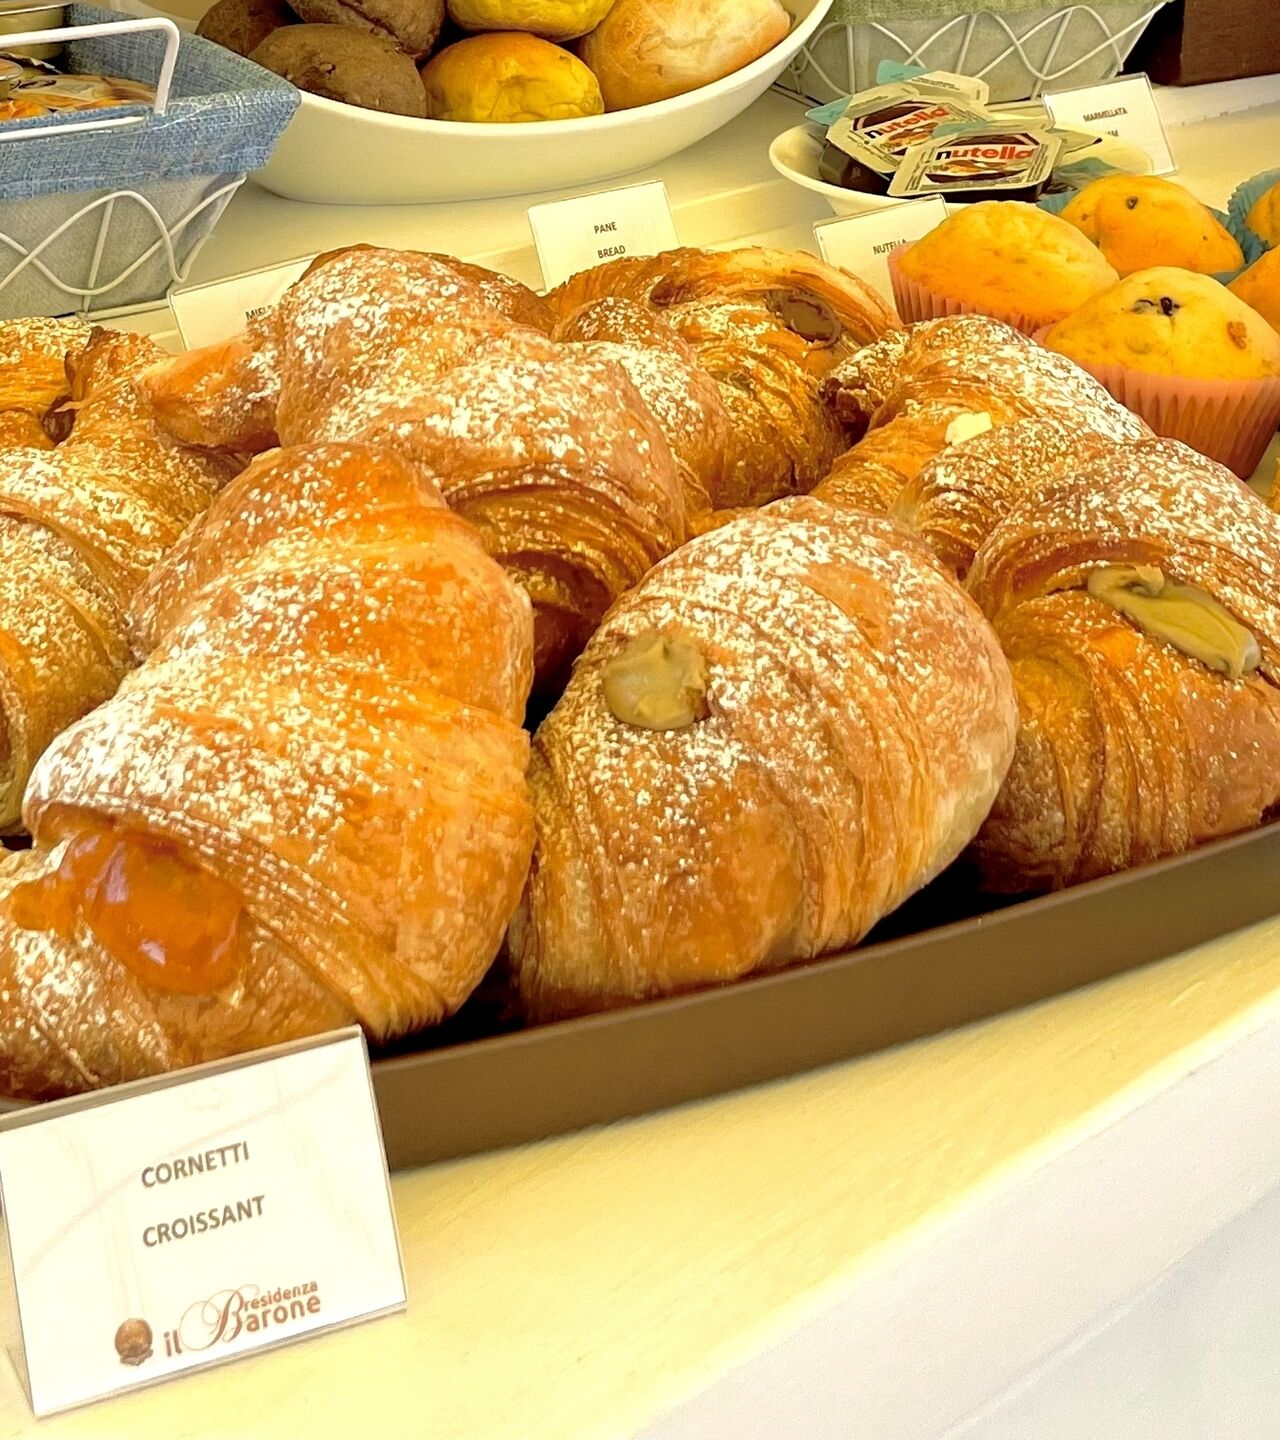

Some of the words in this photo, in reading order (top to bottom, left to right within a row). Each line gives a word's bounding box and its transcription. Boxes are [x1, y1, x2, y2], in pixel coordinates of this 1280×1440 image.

[864, 106, 950, 140] nutella
[1083, 107, 1128, 122] MARMELLATA
[935, 146, 1034, 161] nutella
[594, 221, 618, 235] PANE
[598, 245, 626, 258] BREAD
[141, 1141, 250, 1188] CORNETTI
[142, 1195, 266, 1248] CROISSANT
[164, 1331, 182, 1357] il
[179, 1284, 321, 1351] Barone
